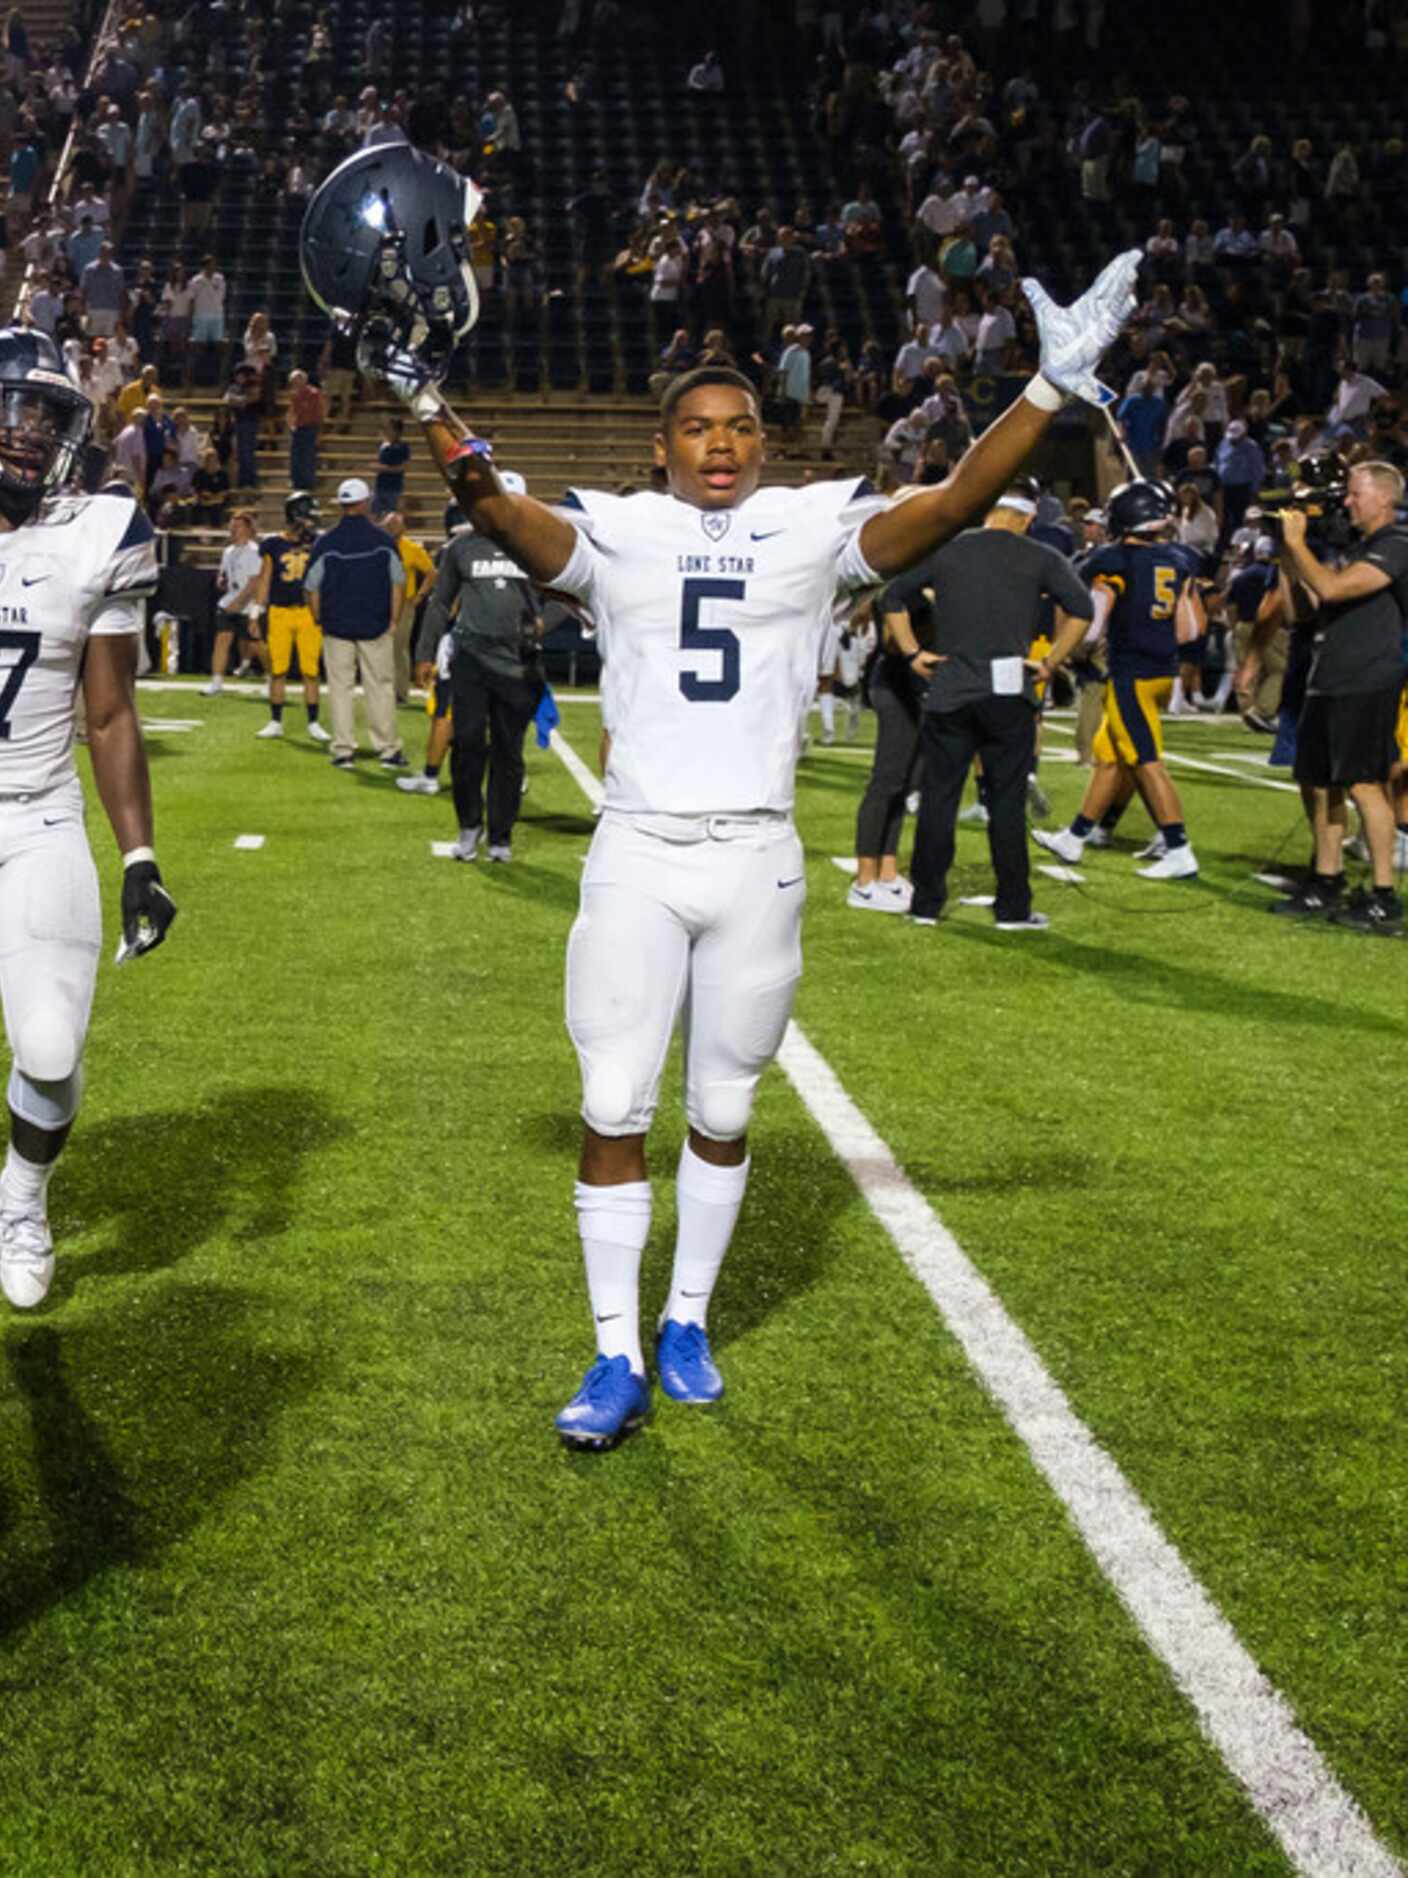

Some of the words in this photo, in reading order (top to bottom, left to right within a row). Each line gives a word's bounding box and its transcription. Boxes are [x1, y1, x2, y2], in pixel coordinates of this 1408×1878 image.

[677, 555, 711, 573] LONE
[718, 556, 754, 573] STAR
[679, 577, 746, 702] 5
